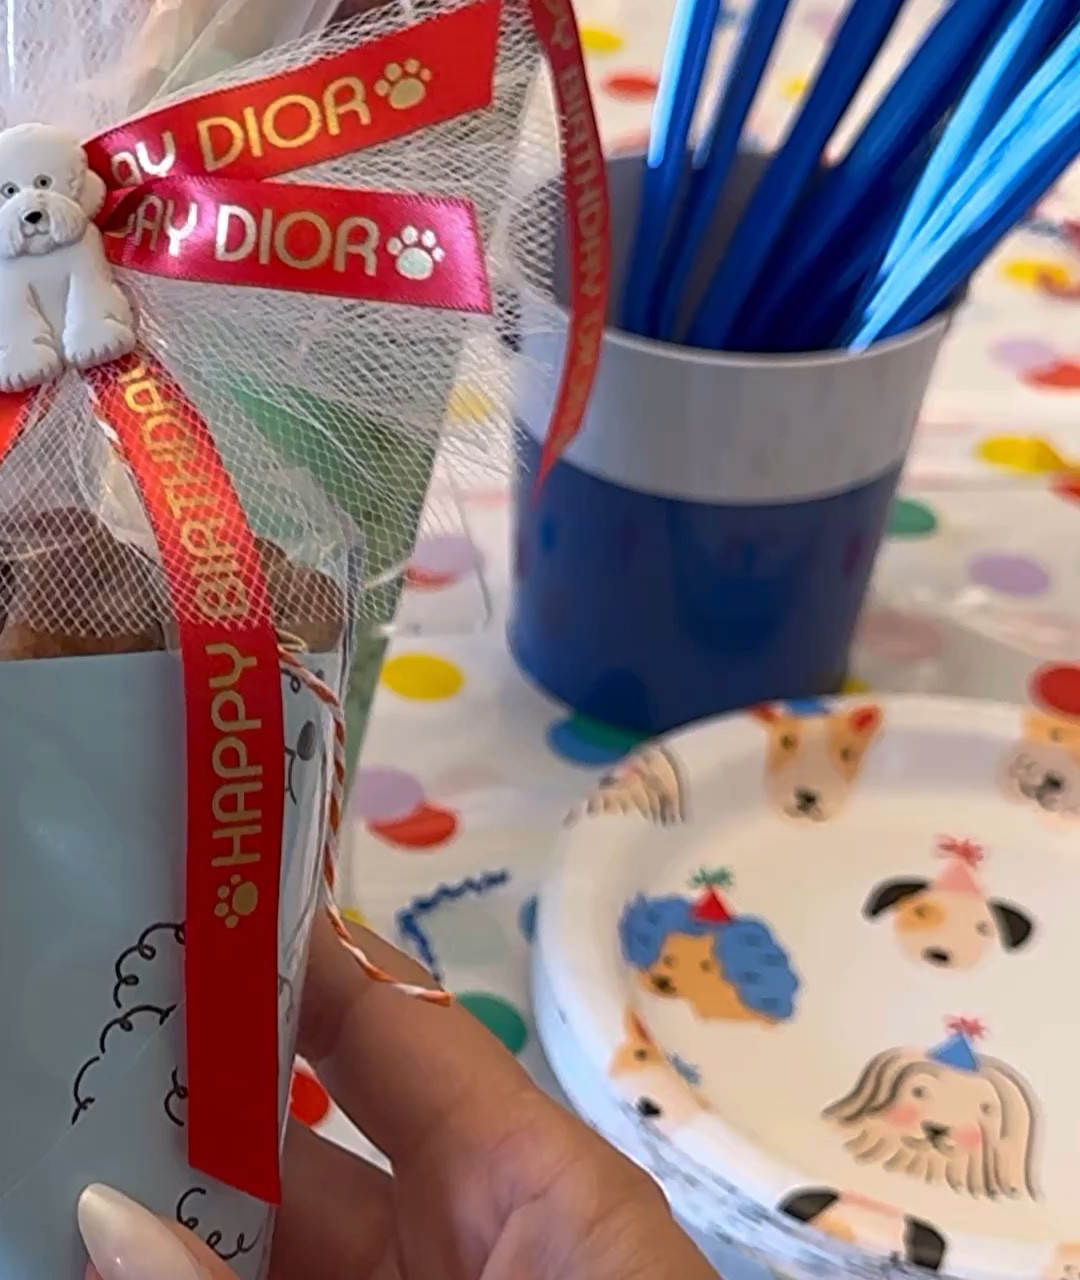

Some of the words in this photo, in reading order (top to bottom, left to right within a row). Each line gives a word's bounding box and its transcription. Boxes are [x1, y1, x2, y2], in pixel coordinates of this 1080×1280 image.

[196, 75, 372, 173] DIOR
[215, 202, 380, 277] DIOR
[204, 642, 264, 868] HAPPY
